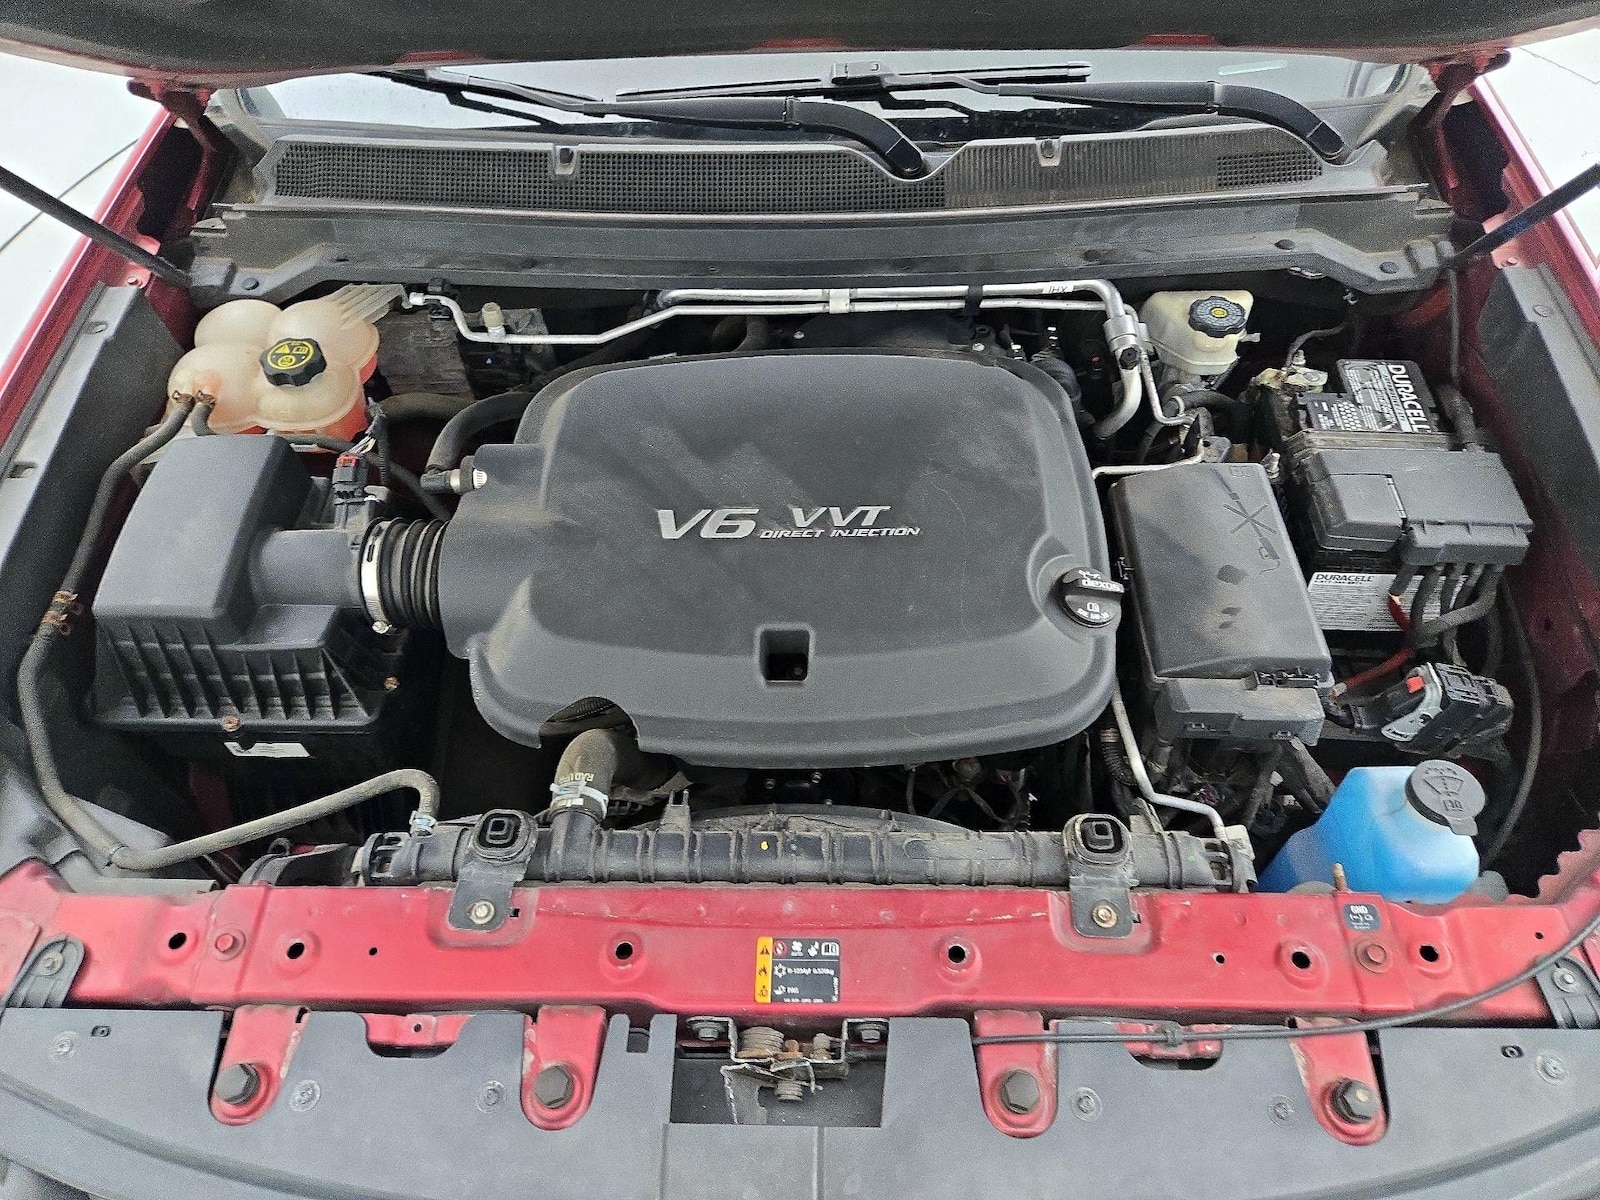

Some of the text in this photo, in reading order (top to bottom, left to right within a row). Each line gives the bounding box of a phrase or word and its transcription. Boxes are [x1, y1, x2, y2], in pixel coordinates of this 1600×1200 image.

[1387, 364, 1431, 433] DURACELL
[656, 505, 892, 539] V6 VVT
[759, 526, 921, 539] DIRECT INJECTION
[1082, 577, 1120, 592] dexos
[1315, 573, 1375, 583] DURACELL
[1350, 905, 1368, 913] GND
